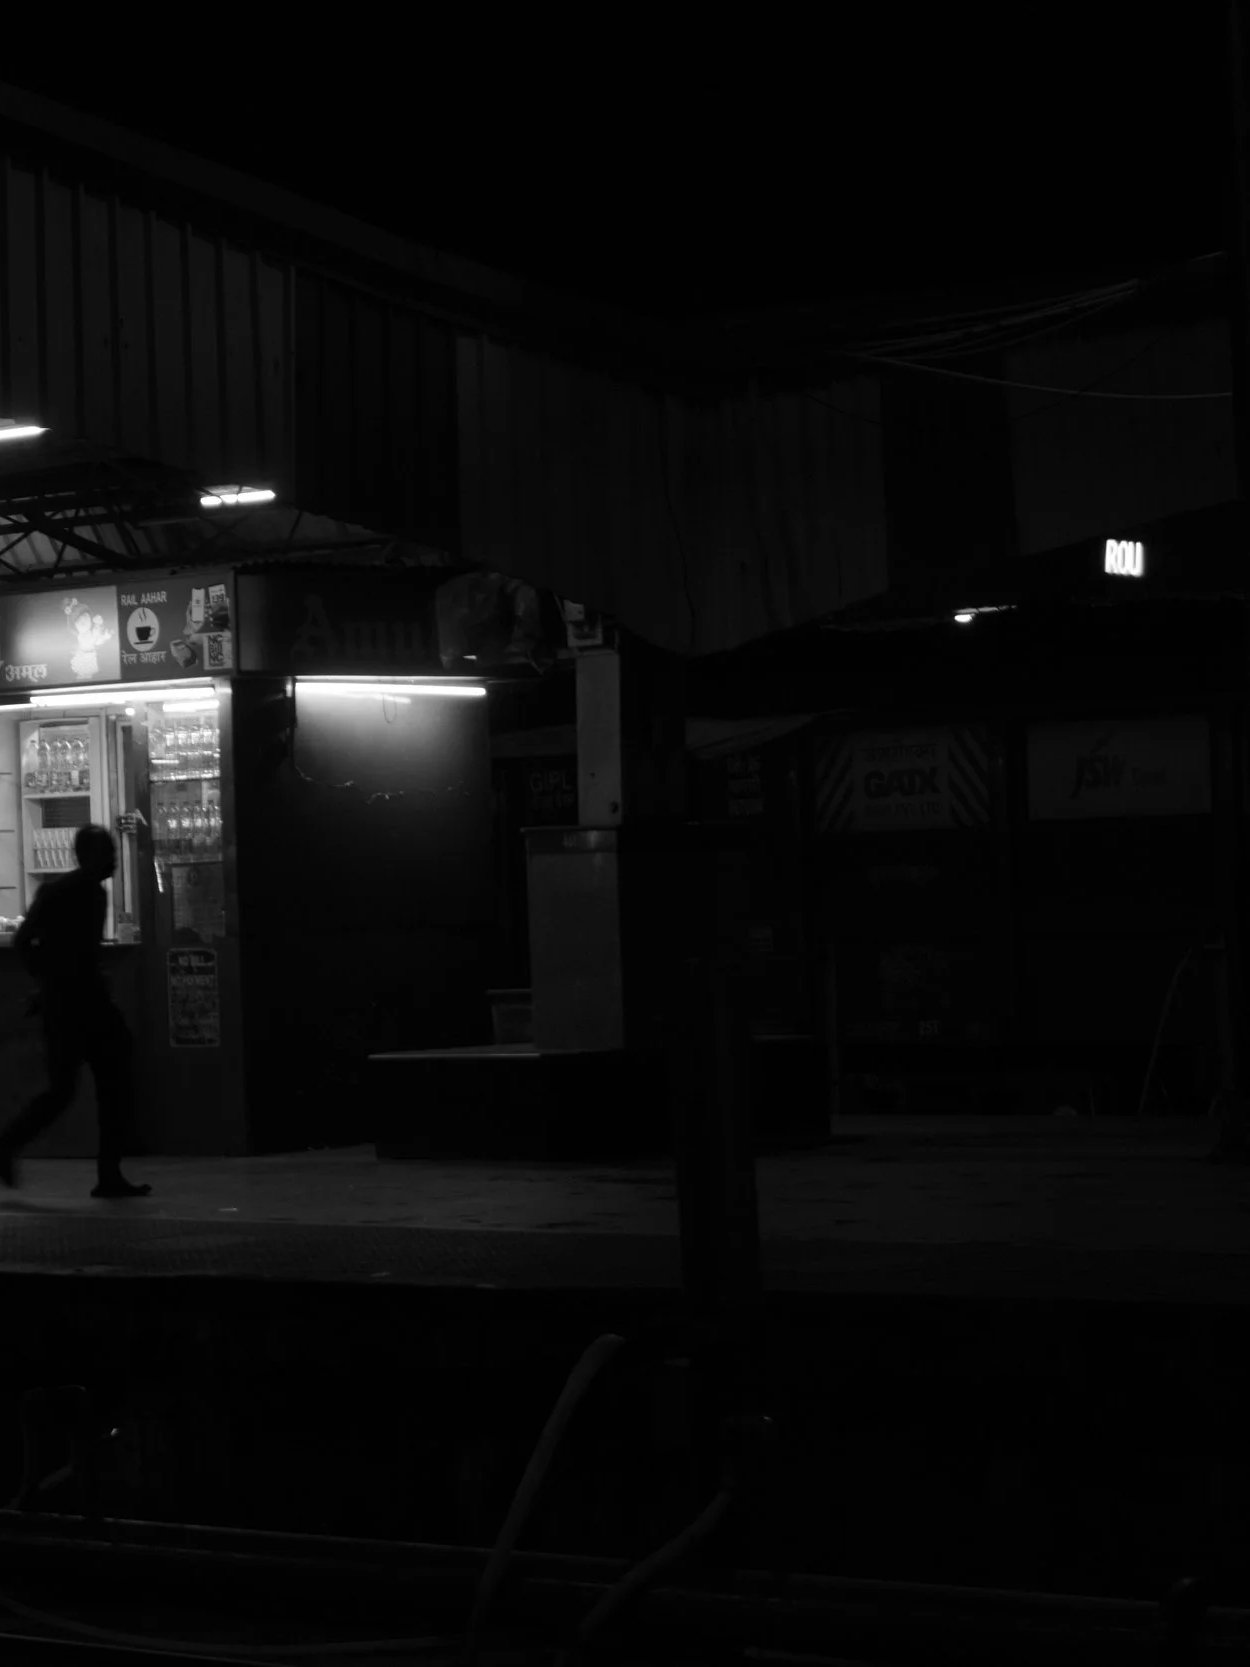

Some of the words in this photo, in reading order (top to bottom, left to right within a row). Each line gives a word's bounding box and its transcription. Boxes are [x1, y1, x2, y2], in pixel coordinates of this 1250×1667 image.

[1105, 539, 1144, 577] ROU
[121, 594, 138, 606] RAIL
[140, 590, 167, 604] AAHAR
[290, 593, 438, 661] Amu
[139, 650, 166, 664] आहार
[864, 766, 942, 799] GATX
[1068, 754, 1127, 800] JSW
